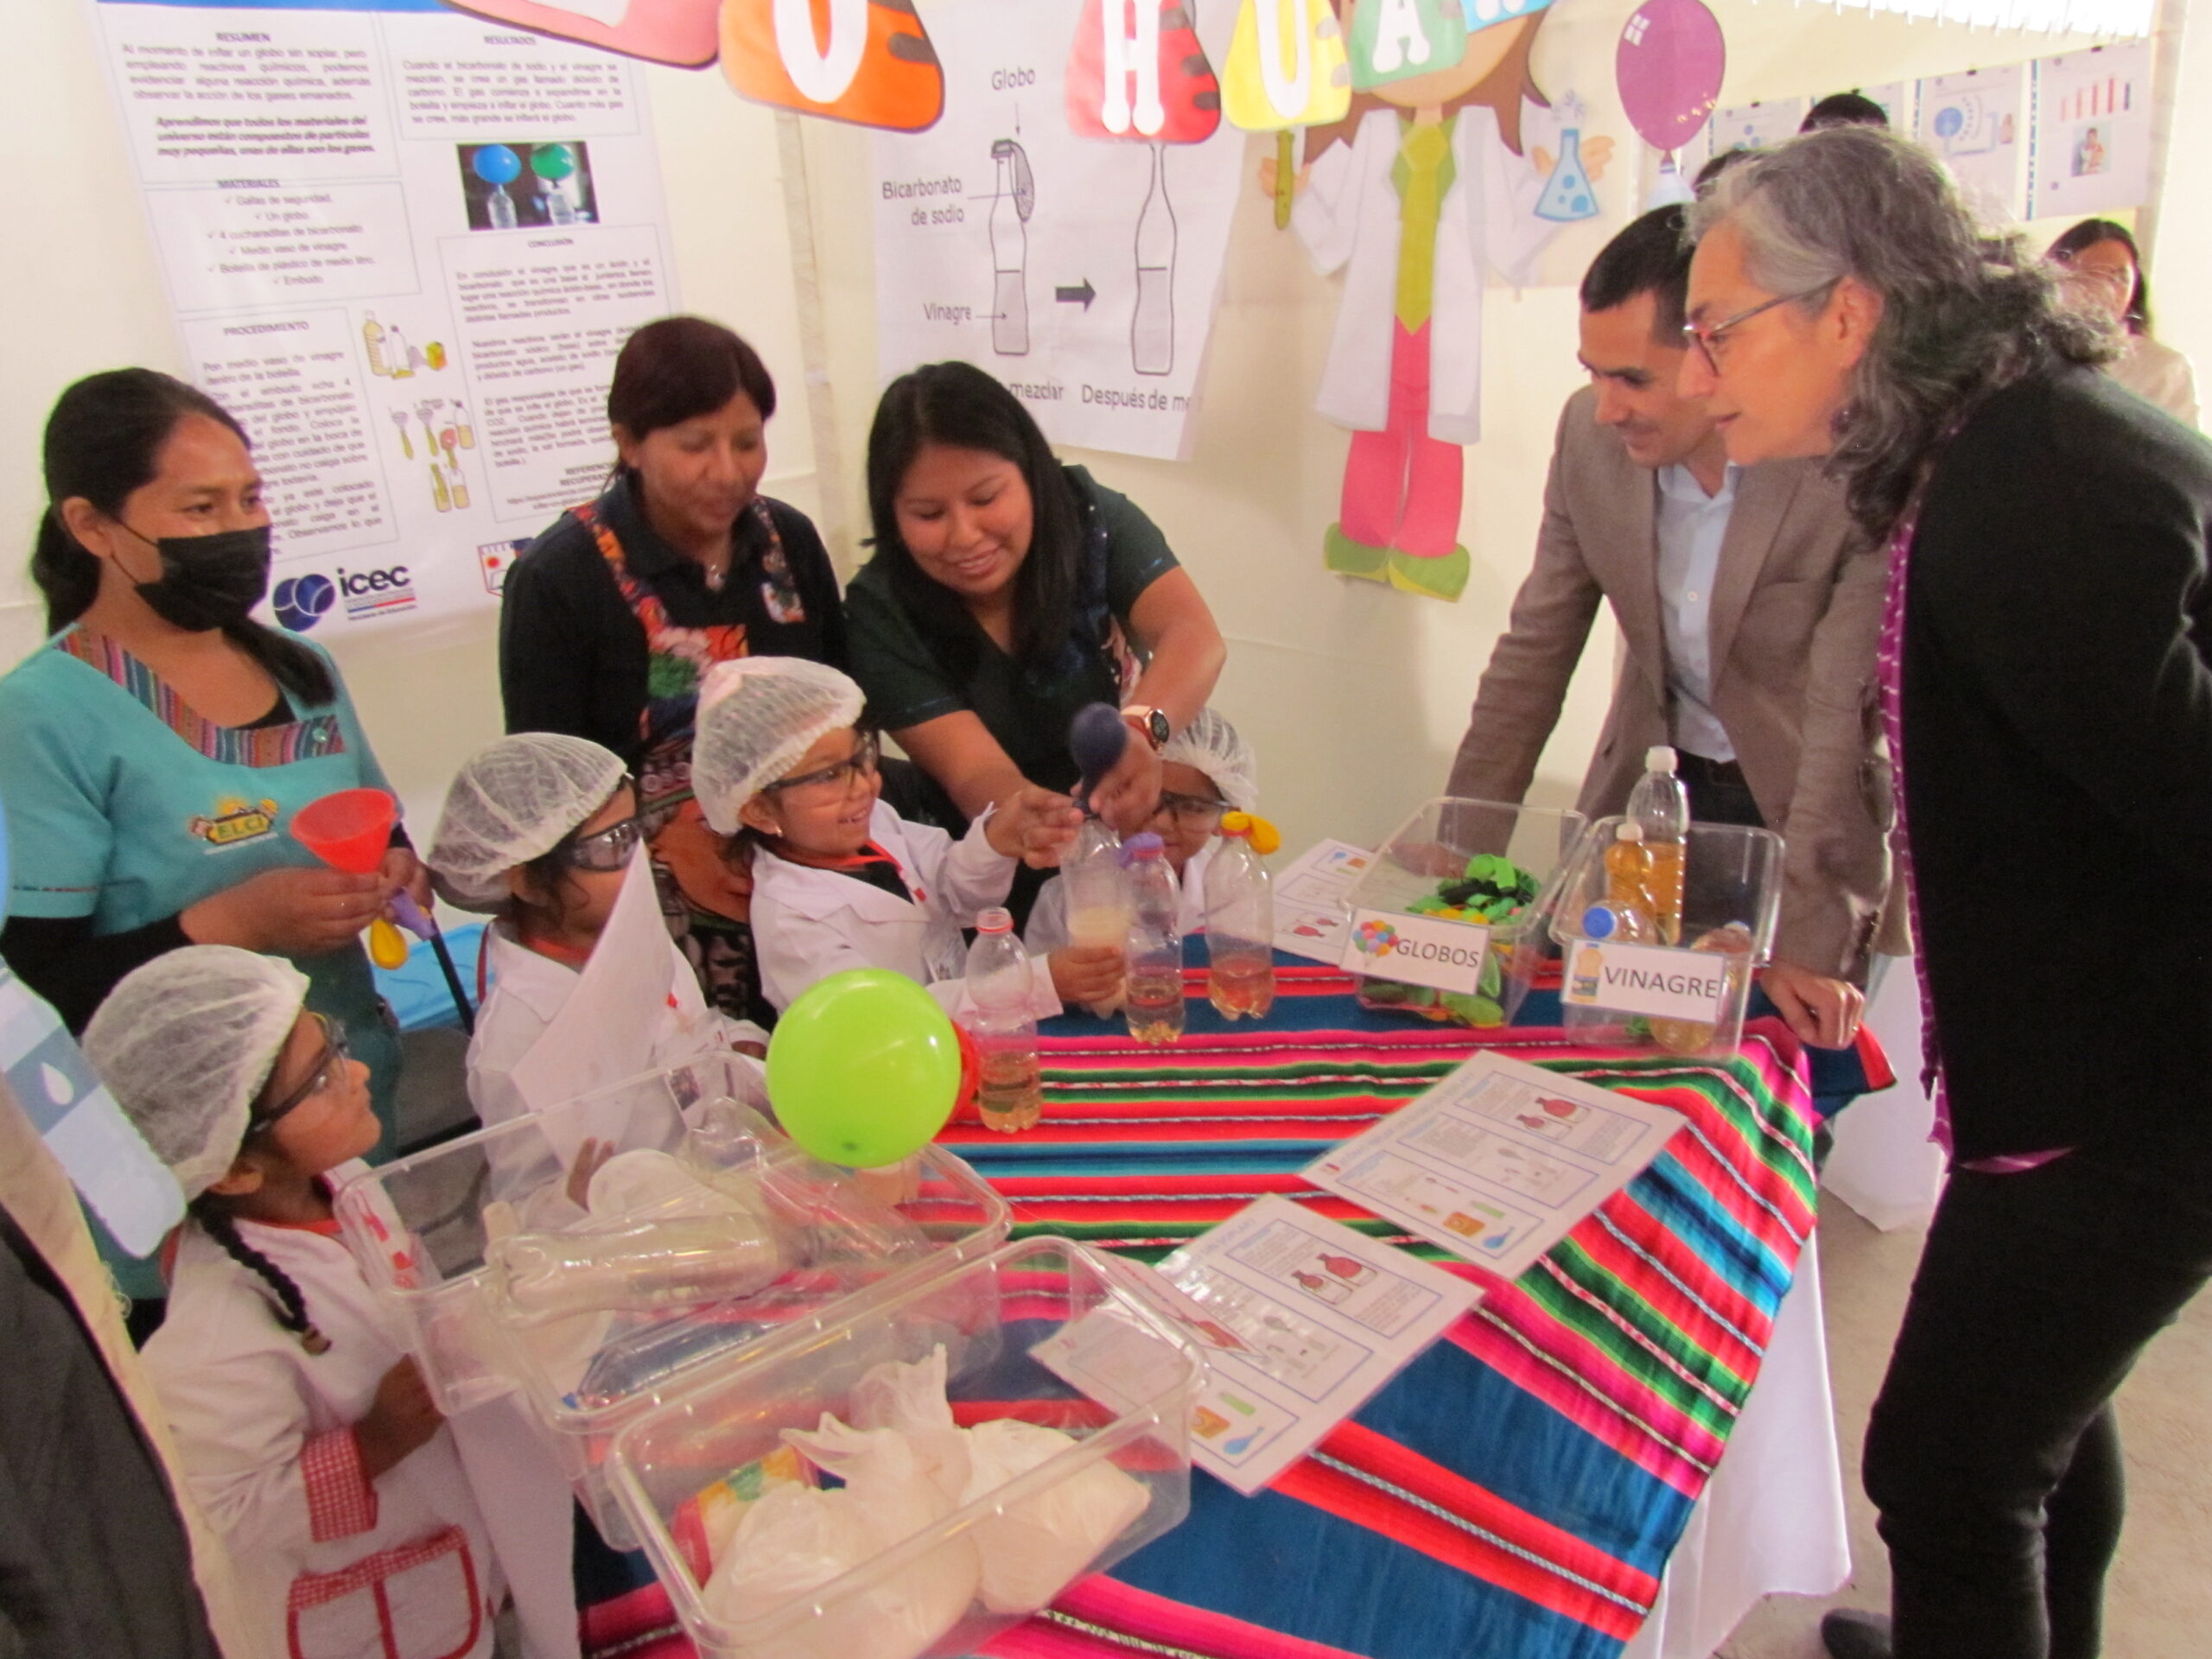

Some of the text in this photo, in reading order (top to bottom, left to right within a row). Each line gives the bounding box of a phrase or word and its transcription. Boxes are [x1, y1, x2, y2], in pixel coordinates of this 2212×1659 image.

[215, 32, 271, 42] RESUMEN
[483, 35, 536, 46] RESULTADOS
[404, 60, 439, 71] Cuando
[456, 60, 506, 71] bicarbonato
[572, 63, 602, 73] vinagre
[991, 67, 1036, 91] Globo
[217, 178, 280, 189] MATERIALES
[882, 177, 963, 200] Bicarbonato
[912, 205, 965, 226] de sodio
[923, 302, 972, 325] Vinagre
[223, 321, 310, 336] PROCEDIMIENTO
[309, 351, 344, 362] vinagre
[297, 391, 354, 404] bicarbonato
[1082, 385, 1145, 410] Después
[1148, 389, 1167, 410] de
[271, 411, 299, 423] globo
[268, 438, 295, 449] globo
[325, 431, 348, 441] boca
[292, 446, 330, 458] cuidado
[342, 453, 368, 464] sobre
[332, 480, 375, 493] colocado
[283, 503, 312, 515] globo
[337, 564, 410, 597] icec
[1395, 938, 1479, 969] GLOBOS
[1605, 965, 1719, 1000] VINAGRE
